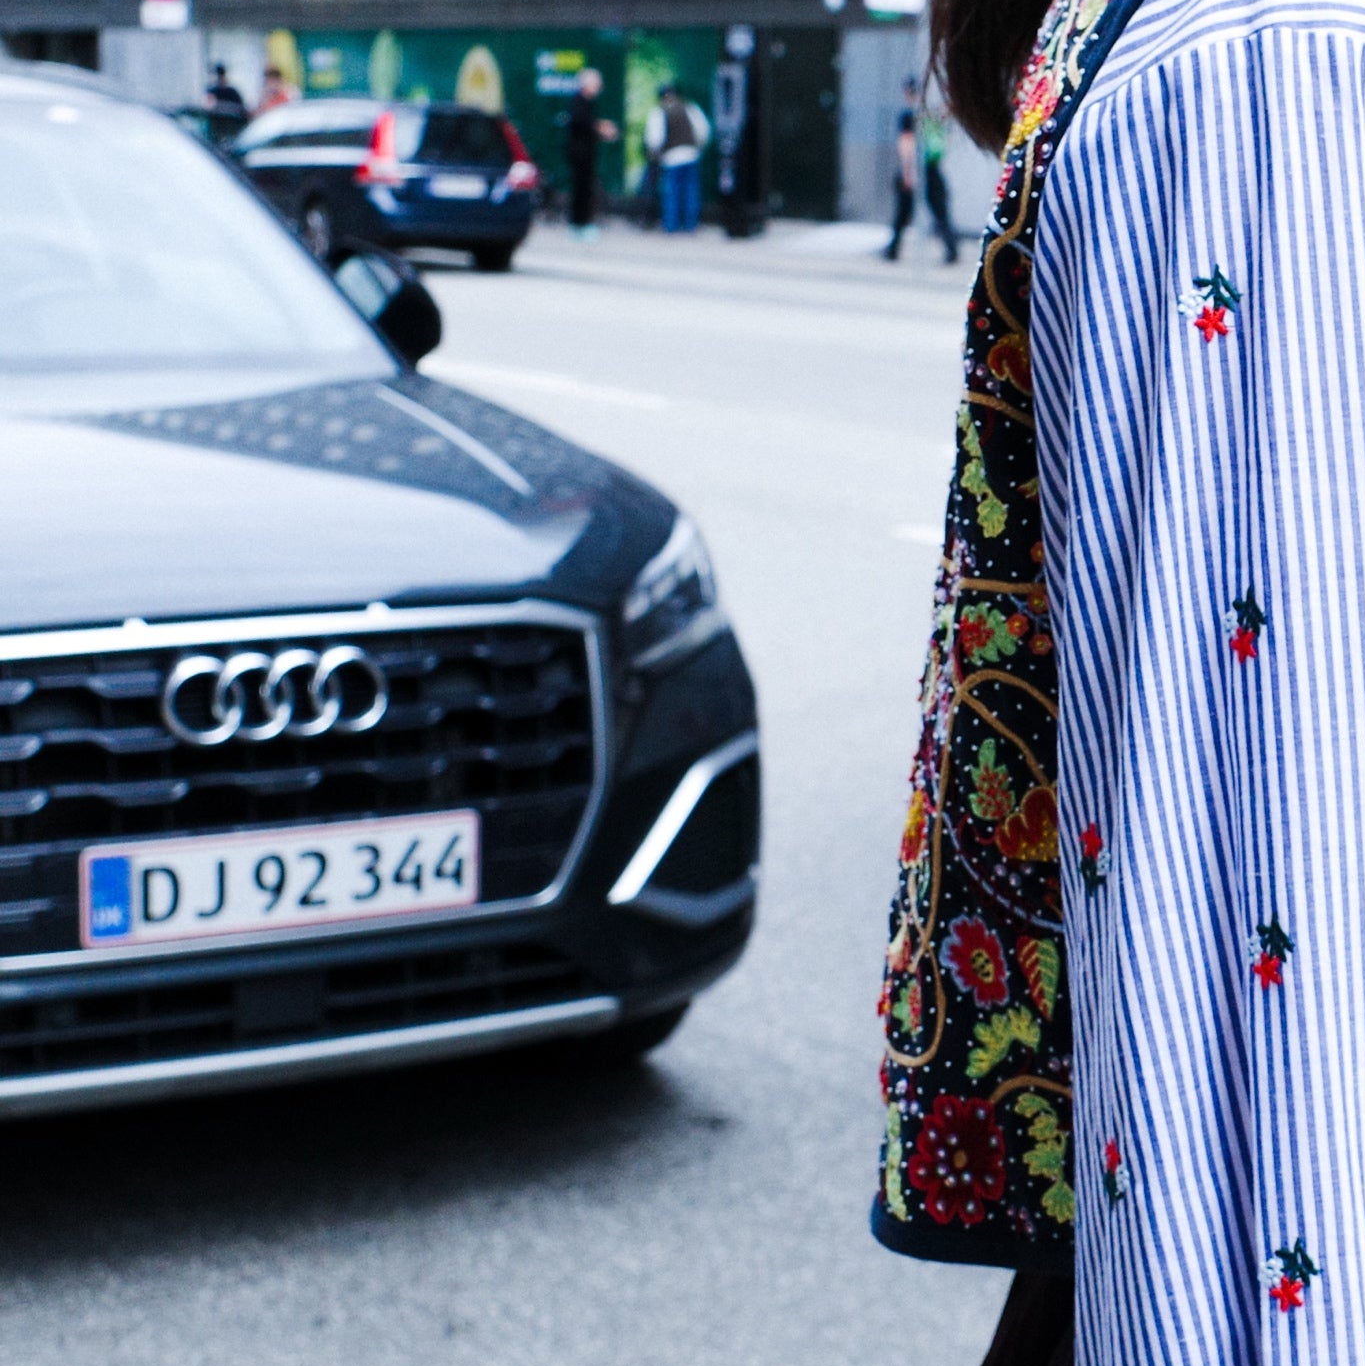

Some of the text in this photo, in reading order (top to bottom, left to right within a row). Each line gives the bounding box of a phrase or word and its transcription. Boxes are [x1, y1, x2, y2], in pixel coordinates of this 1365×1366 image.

[141, 835, 463, 923] DJ 92 344
